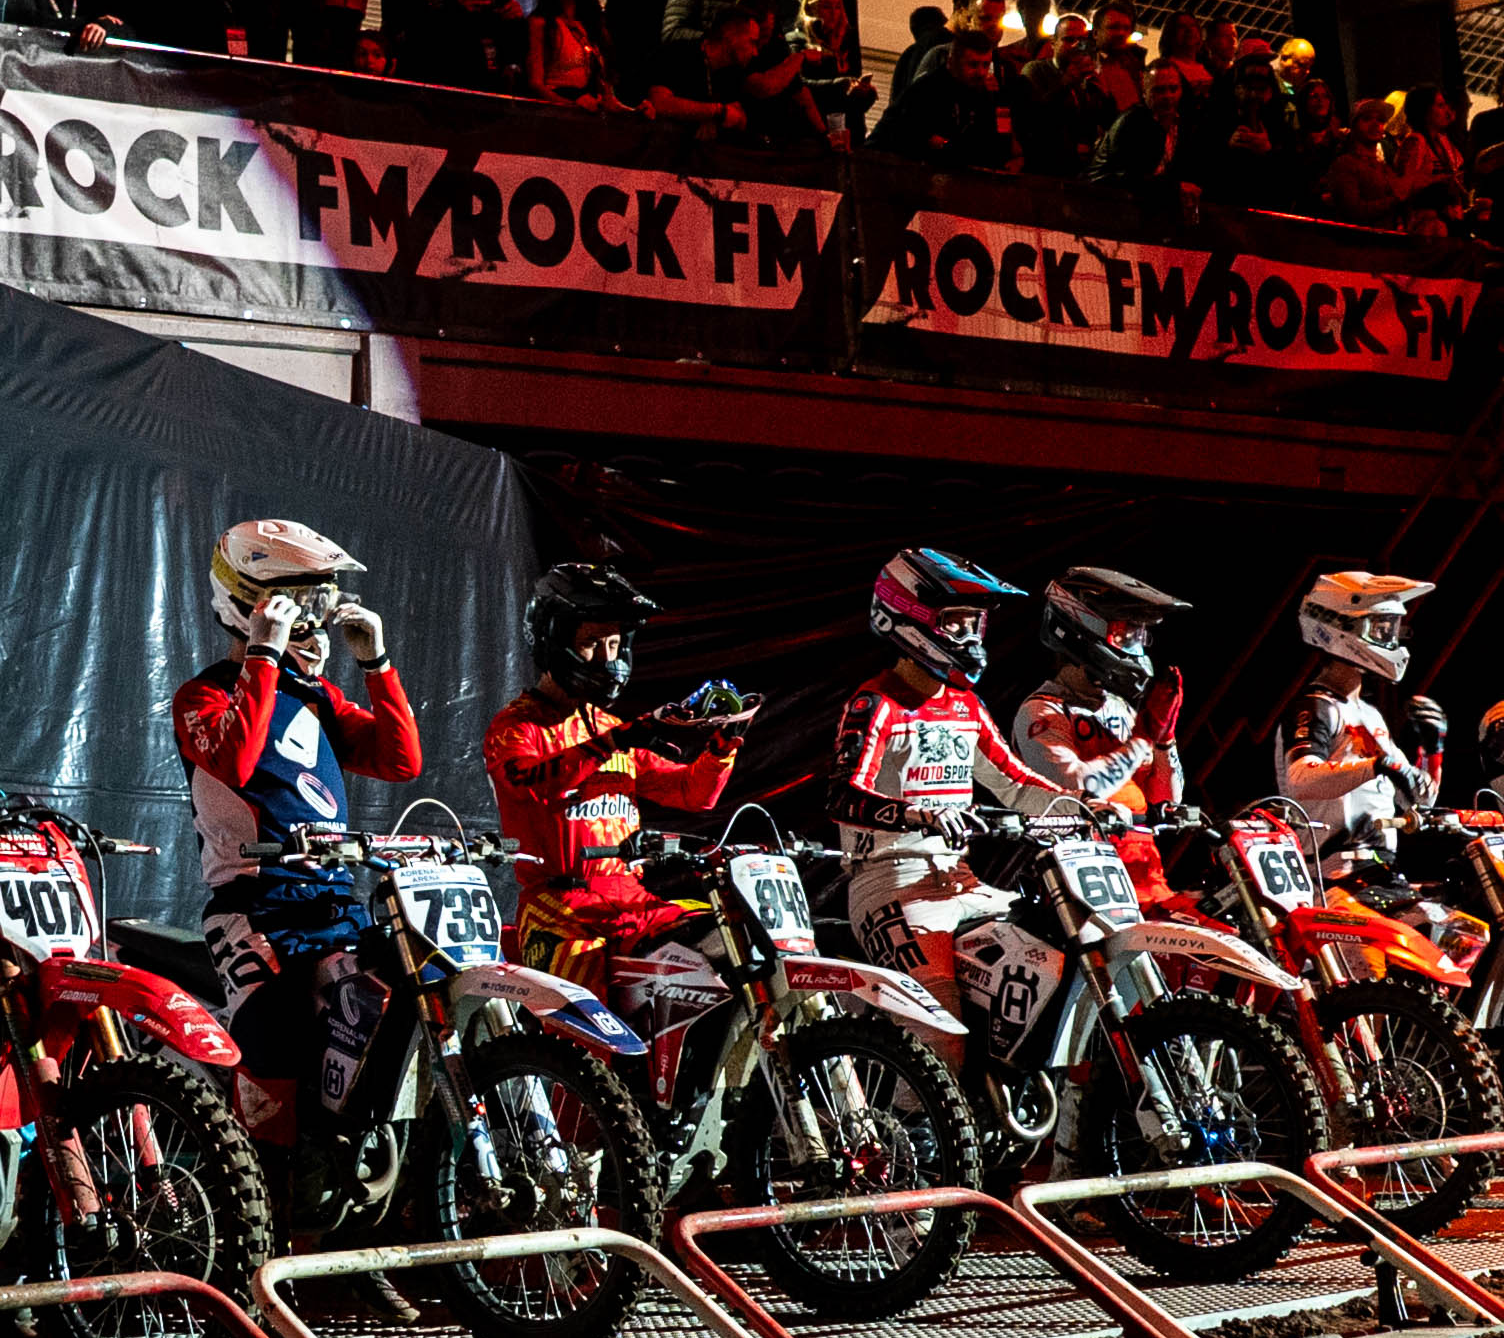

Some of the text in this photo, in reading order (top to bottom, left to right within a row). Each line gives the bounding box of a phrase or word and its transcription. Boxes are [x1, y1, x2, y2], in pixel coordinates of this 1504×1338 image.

[298, 151, 410, 249] FM
[451, 154, 819, 290] ROCK FM
[896, 228, 1192, 337] ROCK FM
[1217, 269, 1463, 362] ROCK FM
[412, 887, 499, 945] 733
[1145, 935, 1206, 950] VIANOVA
[1315, 931, 1364, 944] HONDA
